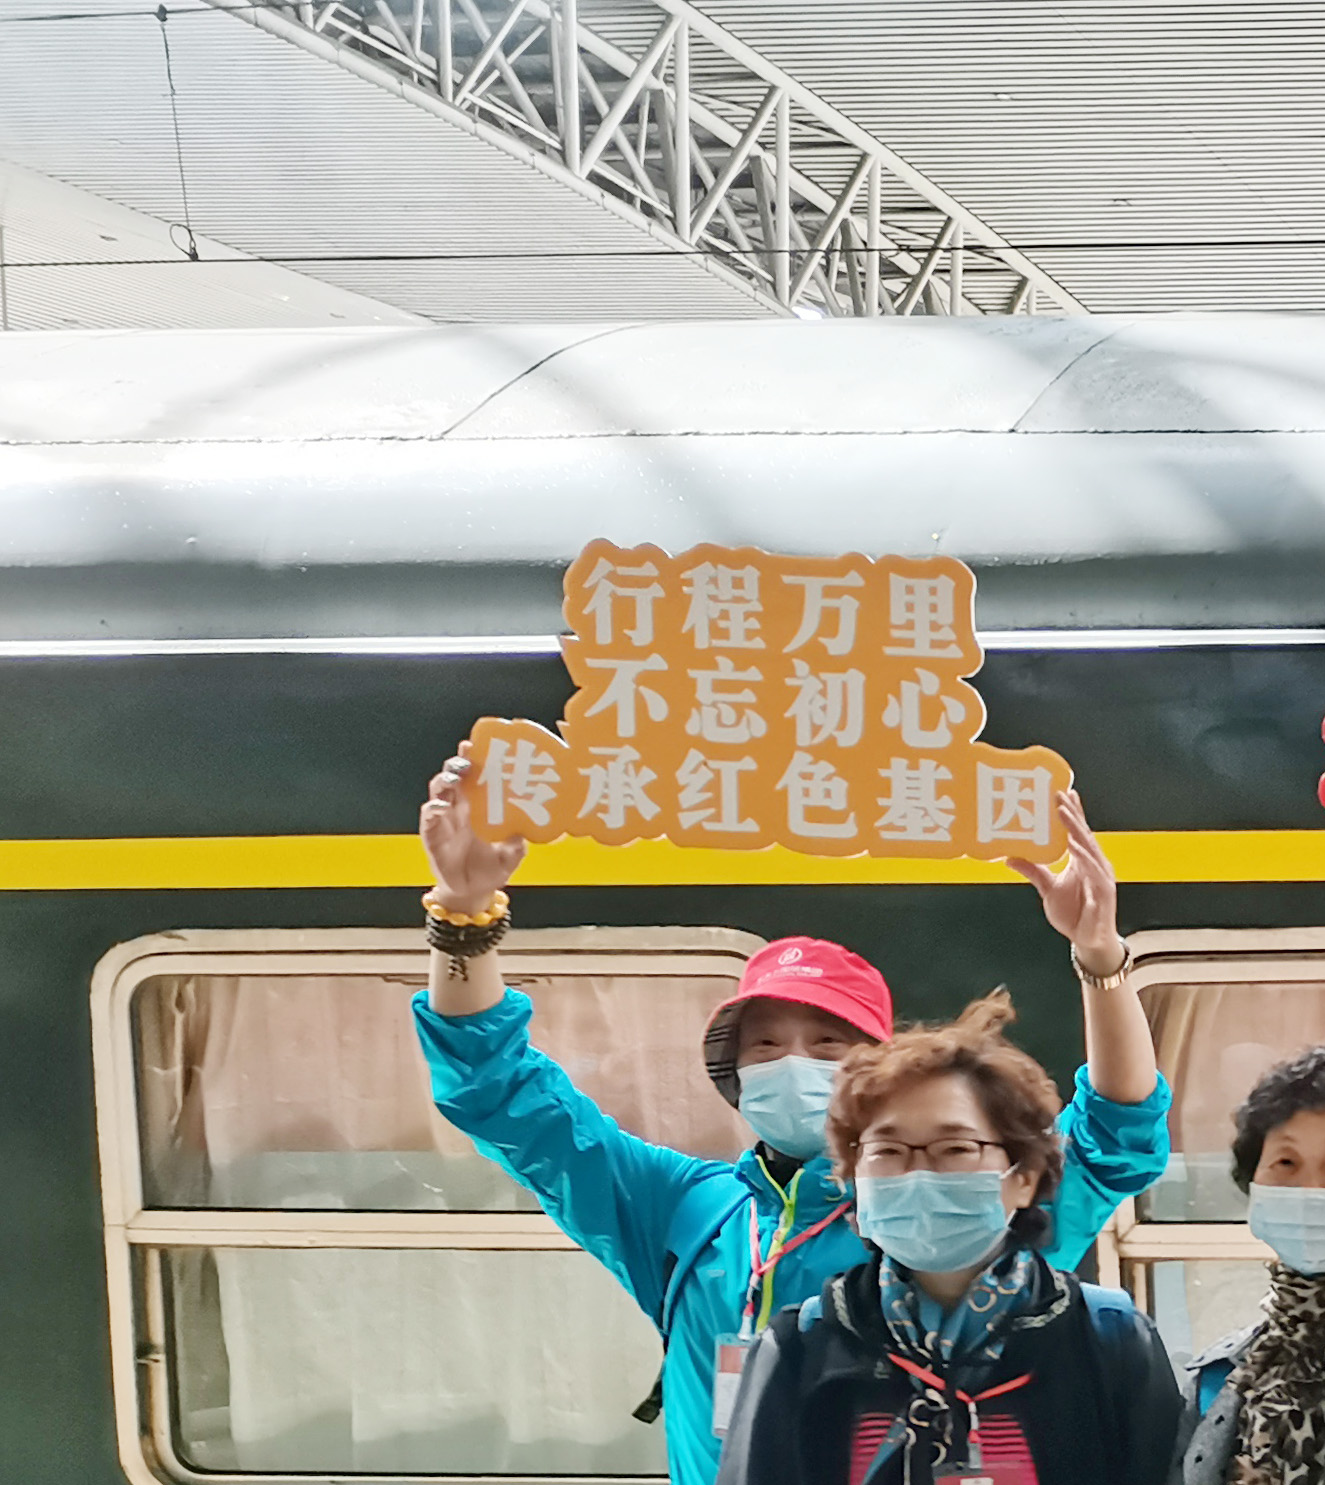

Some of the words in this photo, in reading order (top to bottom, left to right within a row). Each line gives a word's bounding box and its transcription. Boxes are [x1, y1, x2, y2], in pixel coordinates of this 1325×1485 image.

[582, 557, 964, 659] 行程万里
[584, 653, 966, 749] 不忘初心
[477, 737, 1053, 845] 传承红色基因
